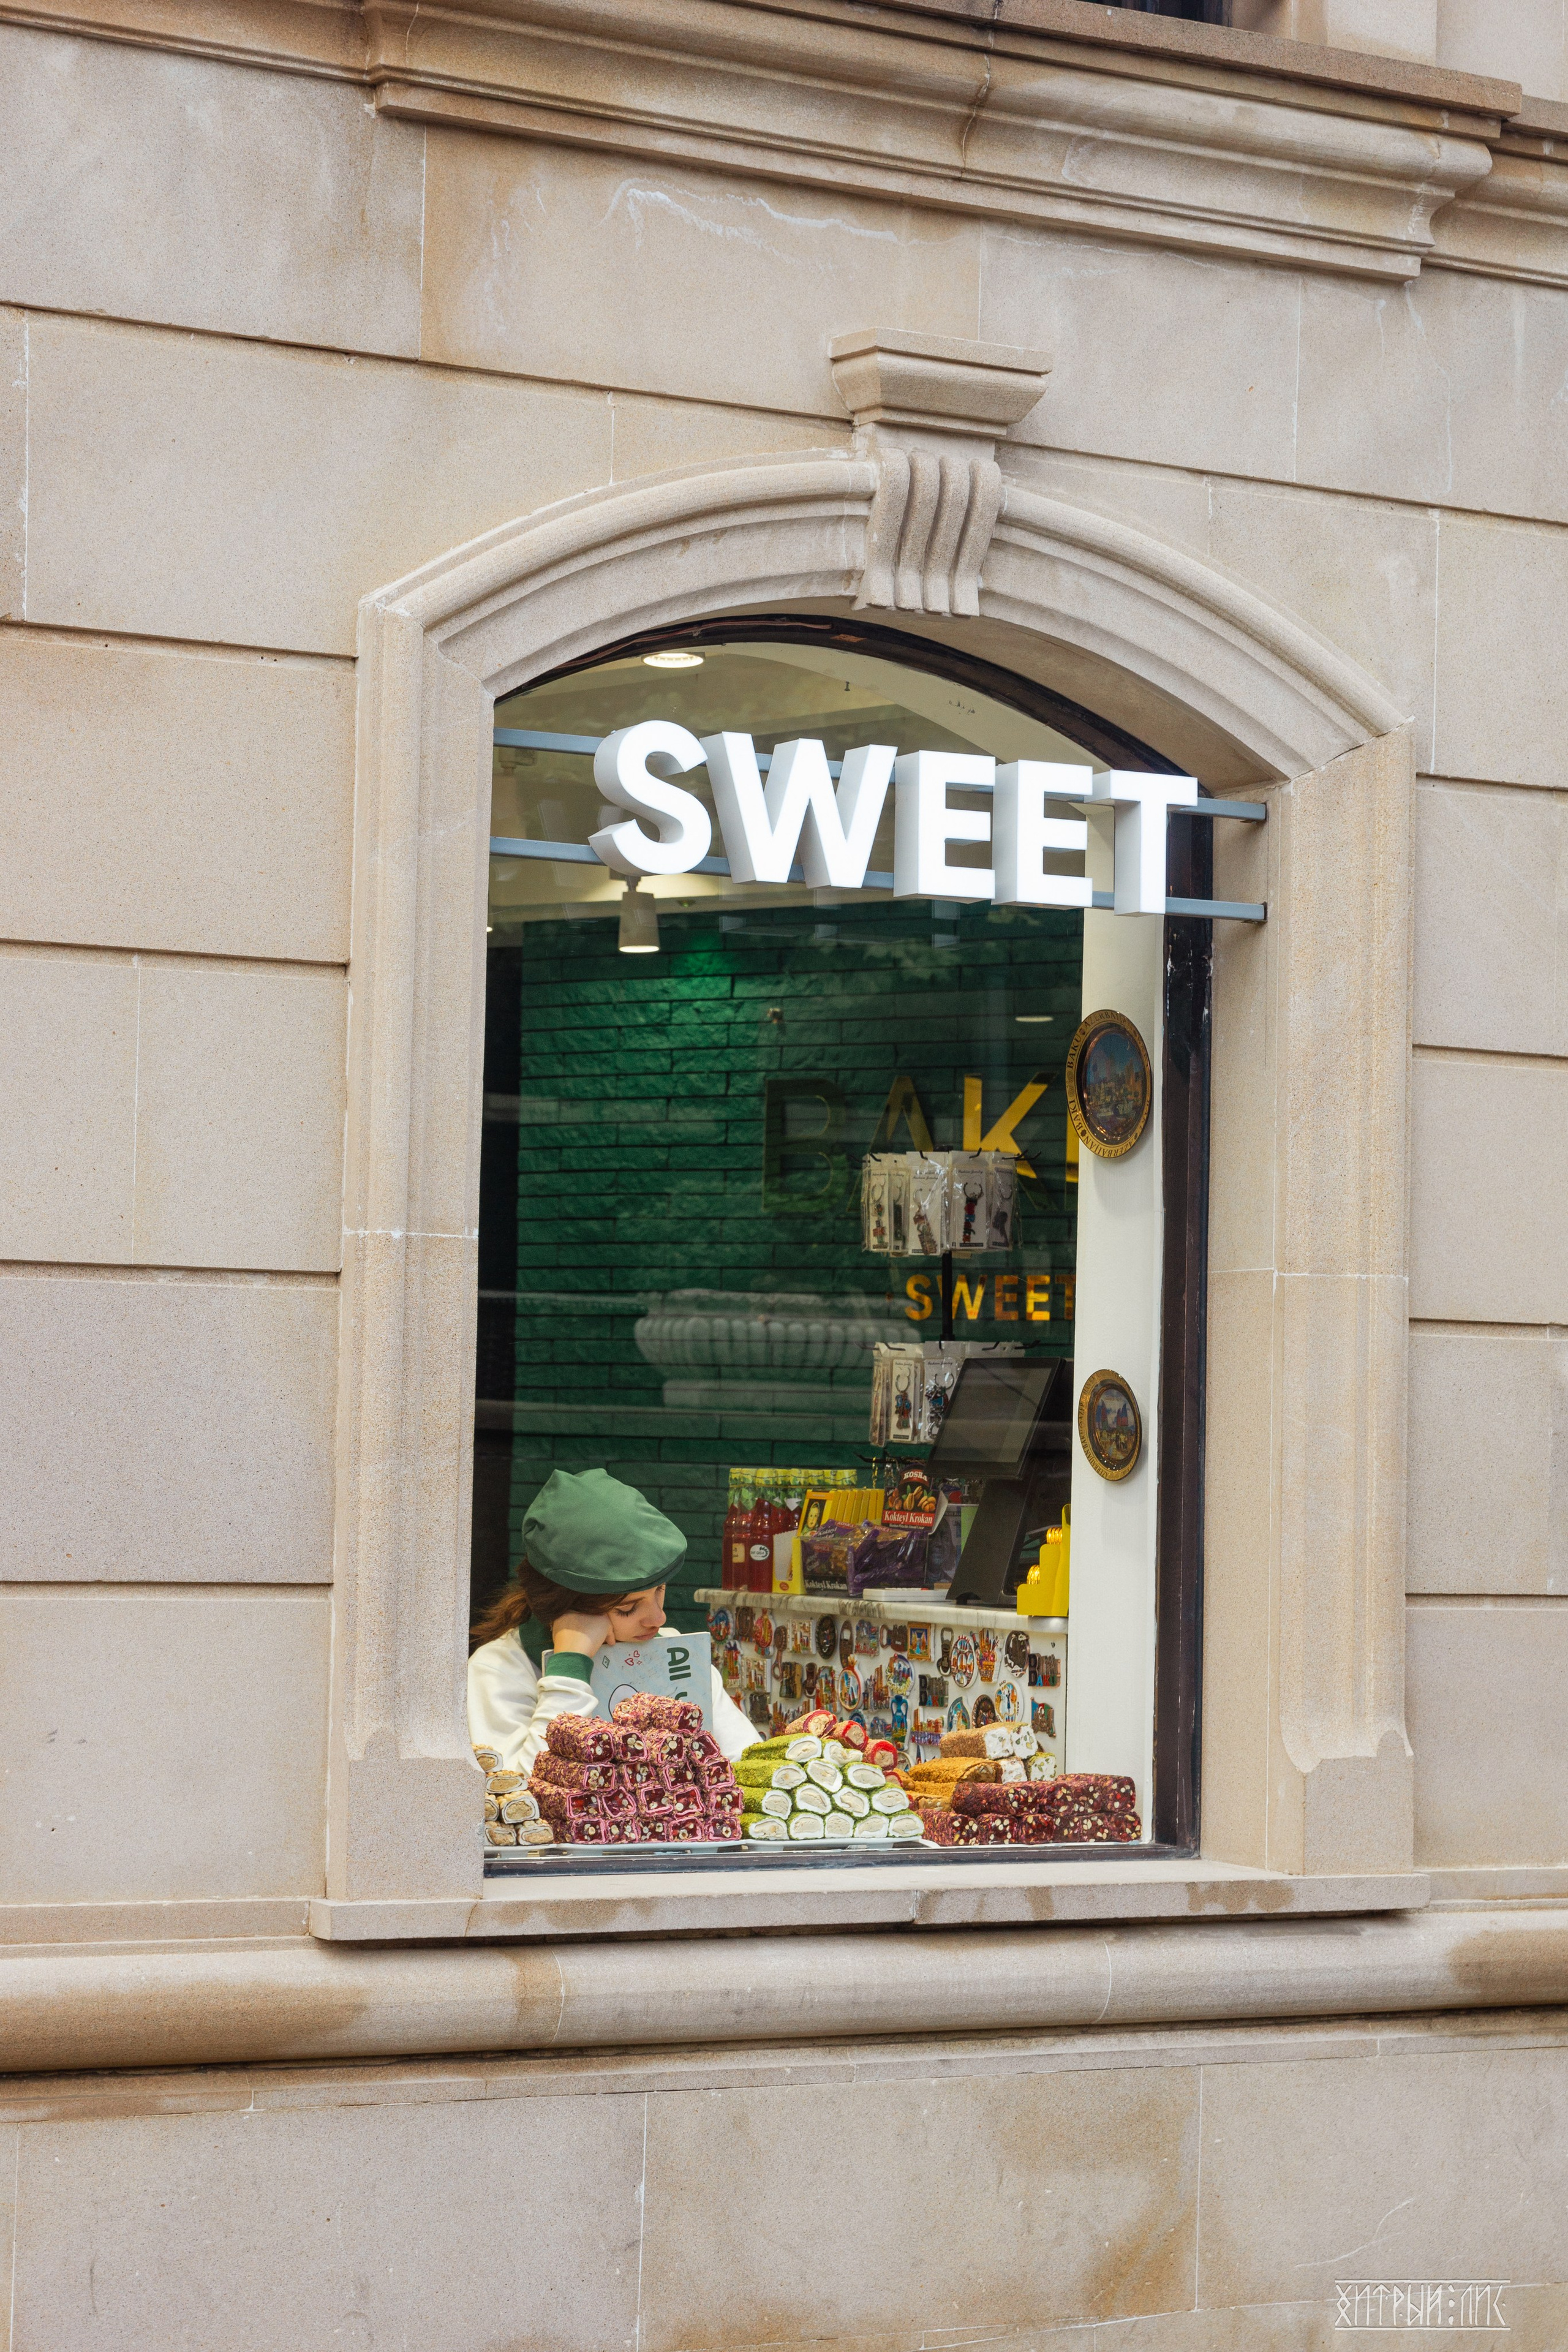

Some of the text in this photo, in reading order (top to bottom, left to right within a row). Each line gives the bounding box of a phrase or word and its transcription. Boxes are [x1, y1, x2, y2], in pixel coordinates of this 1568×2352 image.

[588, 719, 1199, 917] SWEET
[1067, 1034, 1082, 1069] BAKU
[1068, 1100, 1085, 1131] BAKI
[761, 1072, 1078, 1213] BAK
[884, 1510, 933, 1524] Kokteyl Krokan
